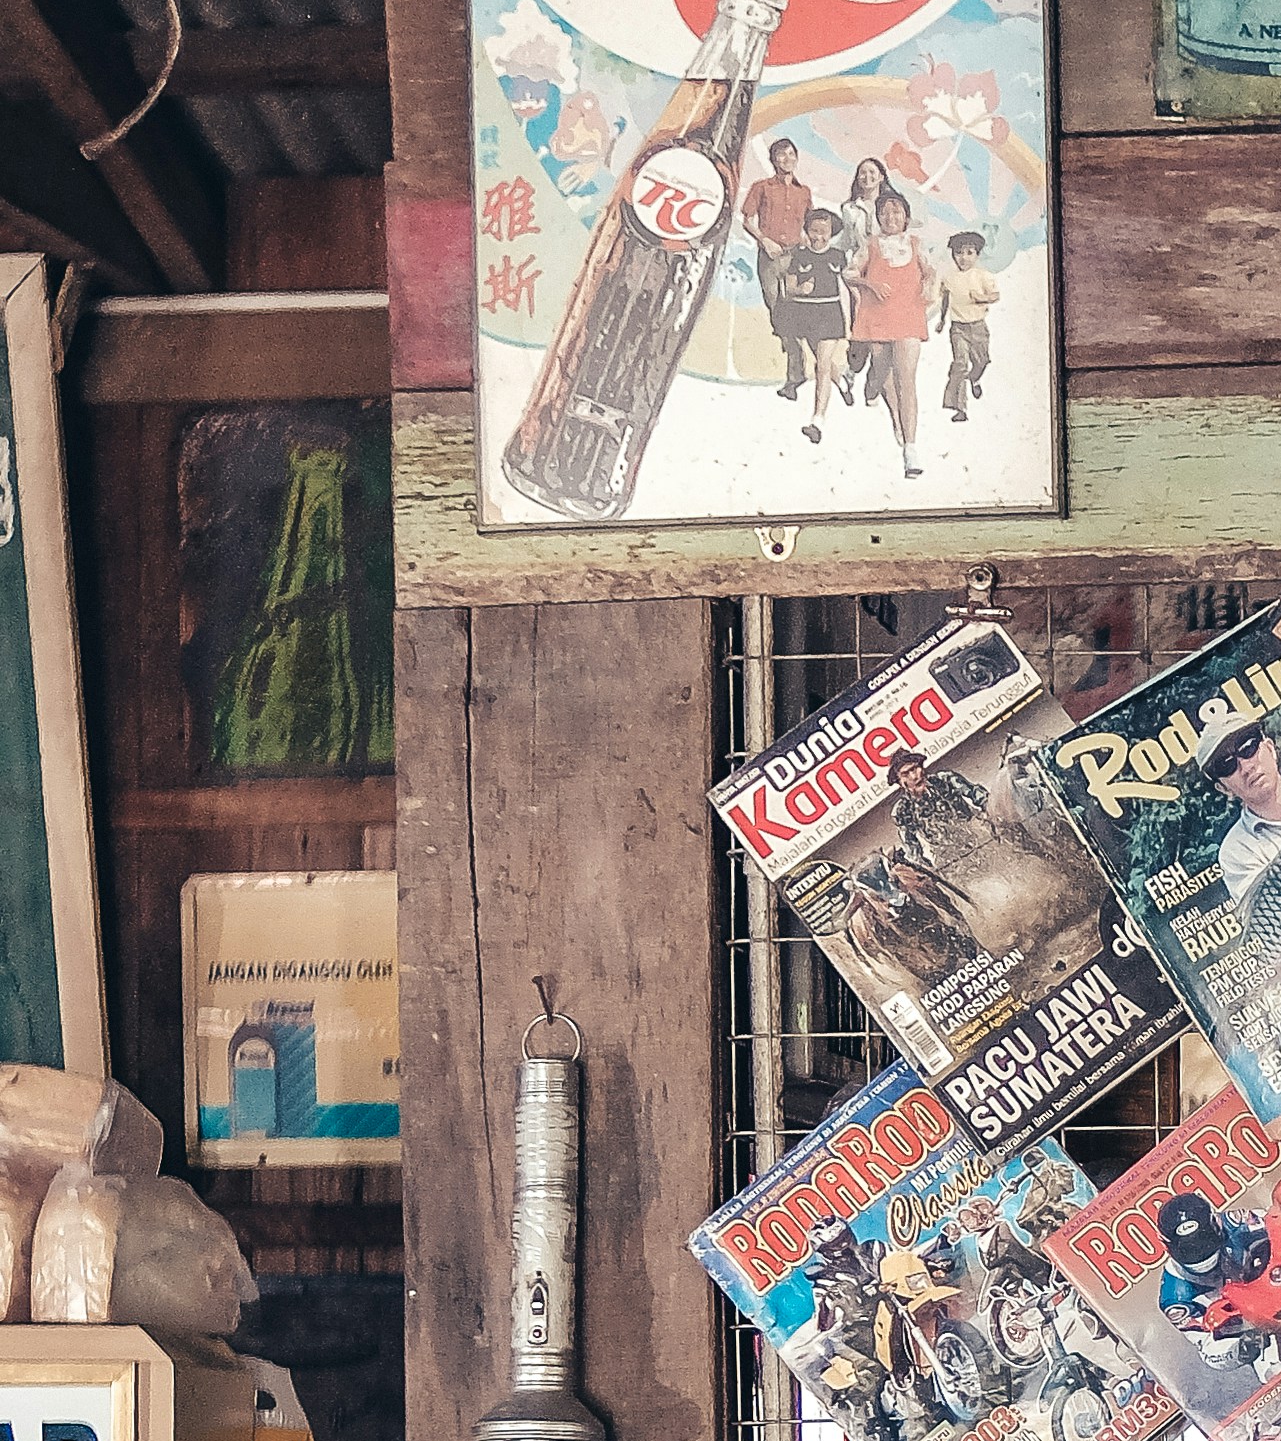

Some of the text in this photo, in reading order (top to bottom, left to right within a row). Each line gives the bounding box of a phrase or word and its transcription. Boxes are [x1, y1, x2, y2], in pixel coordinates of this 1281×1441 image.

[727, 687, 954, 858] Kamera
[1143, 859, 1191, 901] FISH
[1154, 862, 1225, 913] PARASITES
[1181, 911, 1245, 964] RAUB
[920, 950, 995, 1010] KOMPOSISI
[928, 946, 1025, 1023] MOD PAPARAN
[939, 977, 1012, 1035] LANGSUNG
[1207, 975, 1231, 998] PM
[950, 965, 1119, 1110] PACU JAWI
[968, 992, 1146, 1139] SUMATERA
